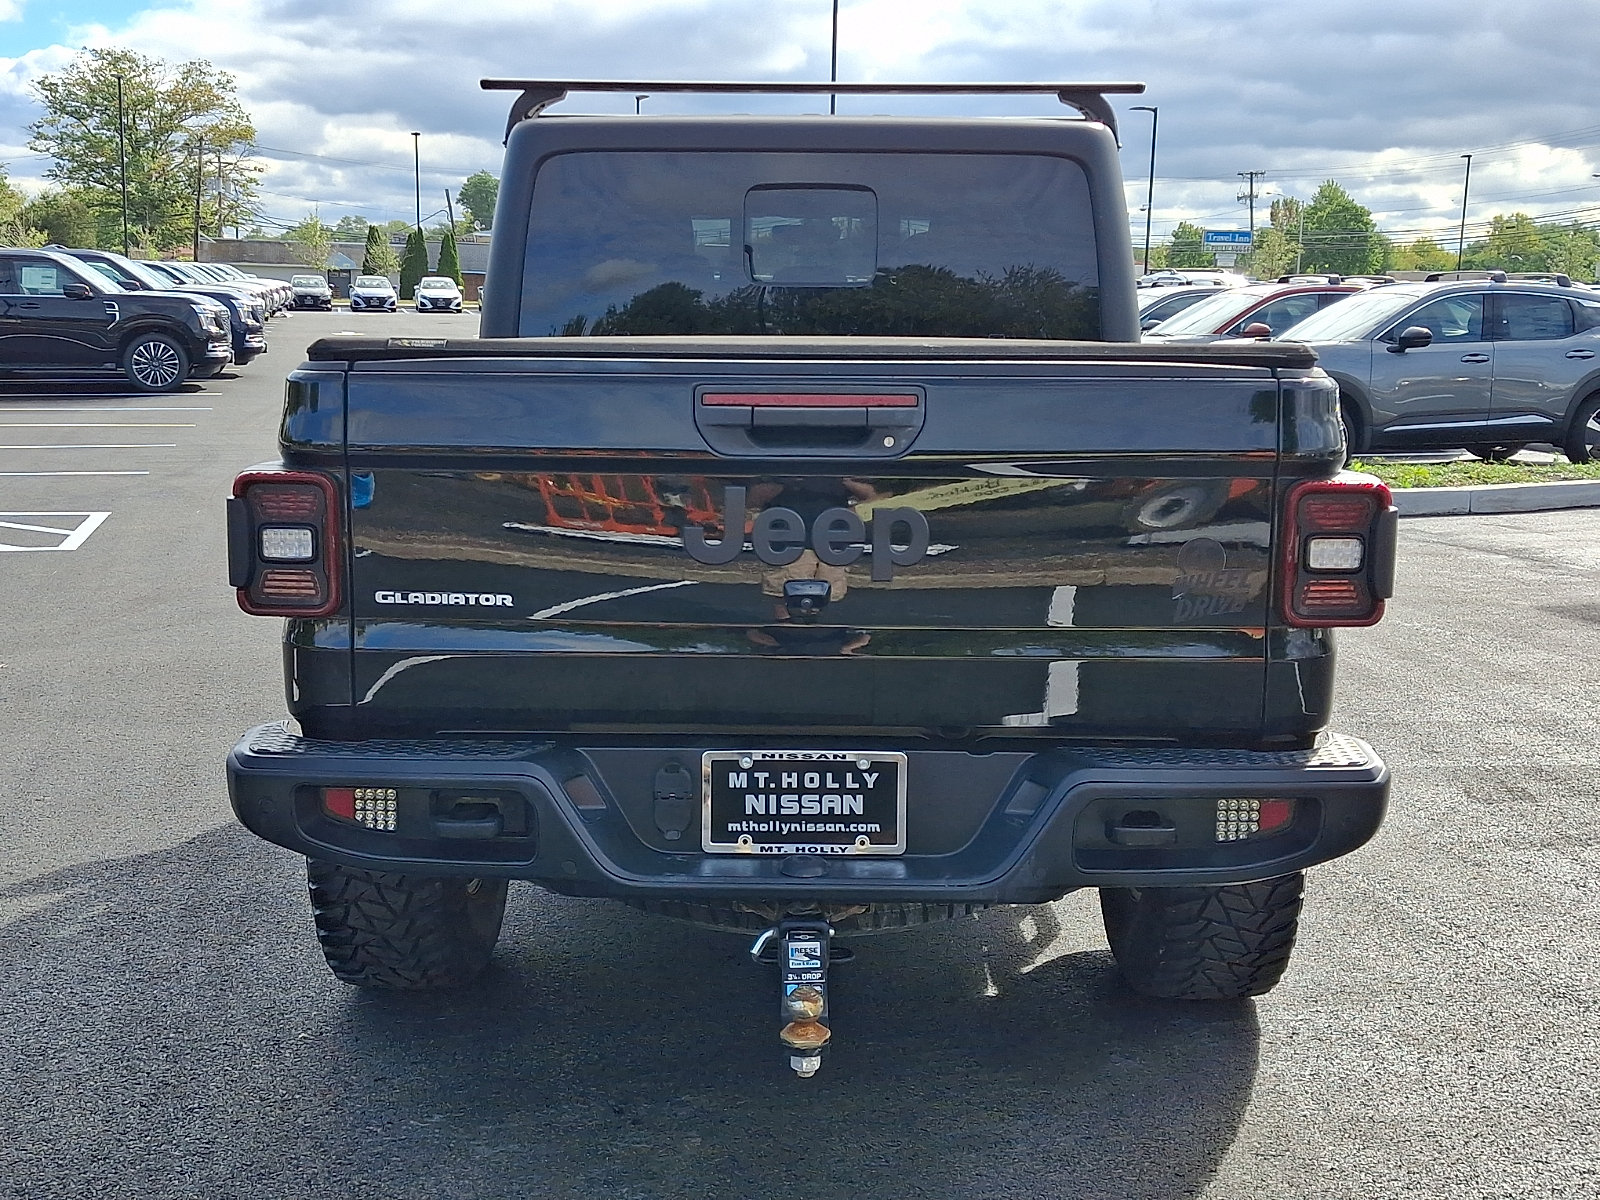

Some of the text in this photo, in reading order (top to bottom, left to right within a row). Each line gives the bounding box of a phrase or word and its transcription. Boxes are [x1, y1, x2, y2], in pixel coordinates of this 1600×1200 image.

[1207, 233, 1249, 243] Travel Inn
[683, 486, 930, 582] Jeep
[374, 590, 514, 607] GLADIATOR
[745, 794, 864, 815] NISSAN
[727, 820, 881, 835] mthollynissan.com
[795, 846, 849, 854] HOLLY
